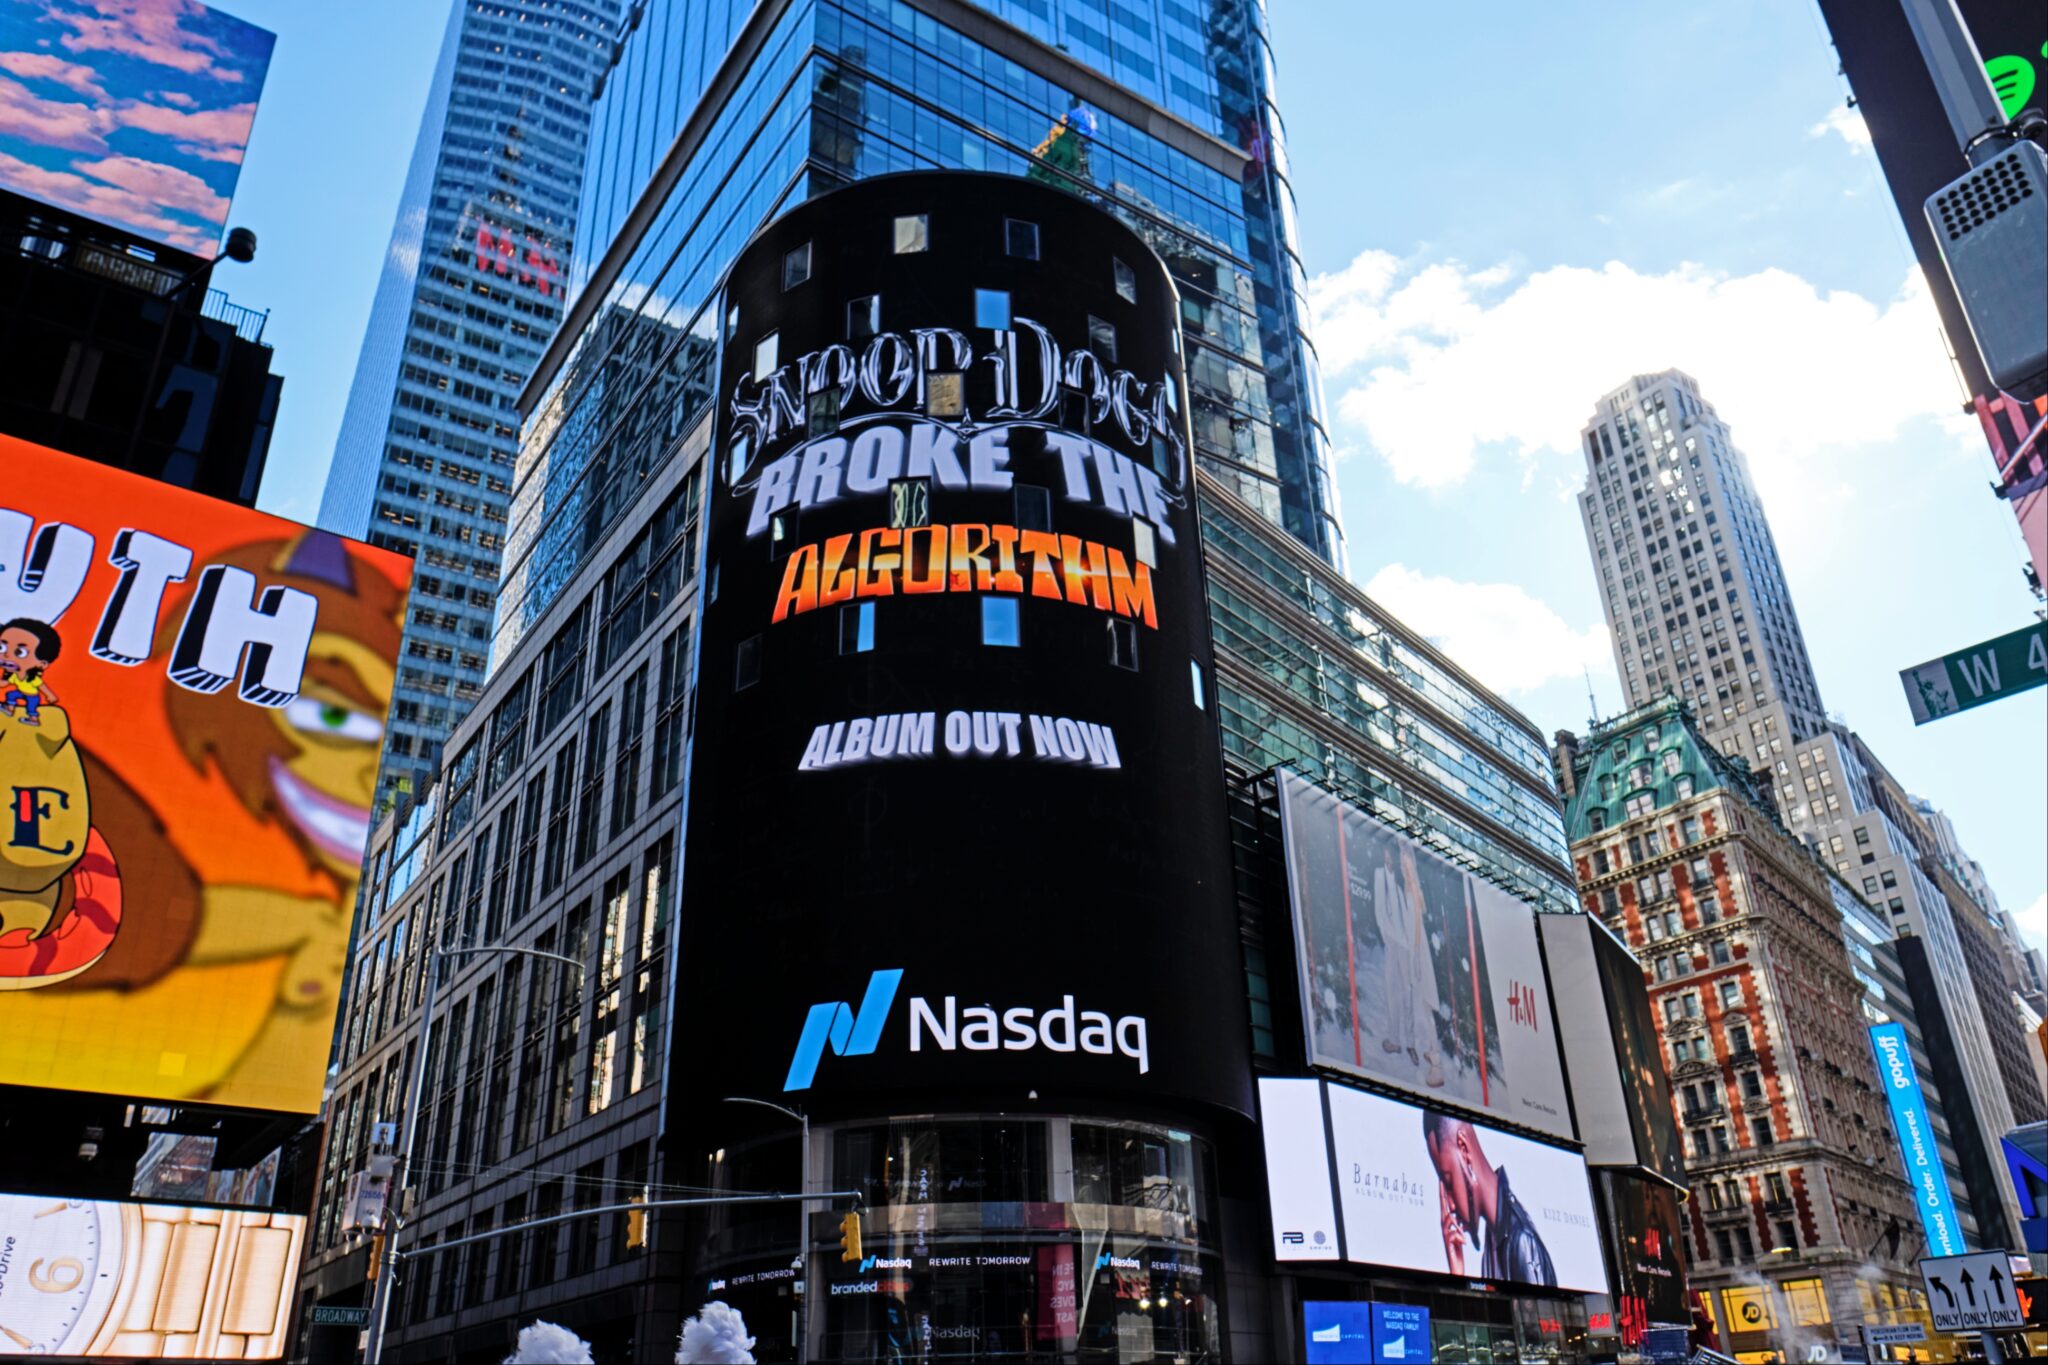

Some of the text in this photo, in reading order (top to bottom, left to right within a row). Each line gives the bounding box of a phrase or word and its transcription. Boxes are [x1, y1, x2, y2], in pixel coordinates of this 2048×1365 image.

[746, 424, 1176, 545] BROKE THE
[771, 523, 1159, 630] ALGORITHM
[1956, 648, 2001, 698] W
[798, 710, 1122, 770] ALBUM OUT NOW
[1507, 980, 1538, 1032] H&M
[909, 994, 1149, 1075] Nasdaq
[1877, 1034, 1910, 1089] gopuff
[1903, 1107, 1929, 1167] Delivered.
[1354, 1163, 1424, 1197] Barnabas
[1922, 1169, 1939, 1208] Order.
[876, 1255, 1031, 1269] Nasdaq REWRITE TOMORROW
[1110, 1256, 1140, 1270] Nasdaq
[314, 1310, 367, 1323] BROADWAY
[1383, 1310, 1403, 1321] WELCOME
[1385, 1321, 1403, 1331] NASDAQ
[1936, 1314, 1960, 1327] ONLY
[1963, 1311, 1989, 1325] ONLY
[1993, 1309, 2019, 1323] ONLY
[1808, 1344, 1828, 1363] JD
